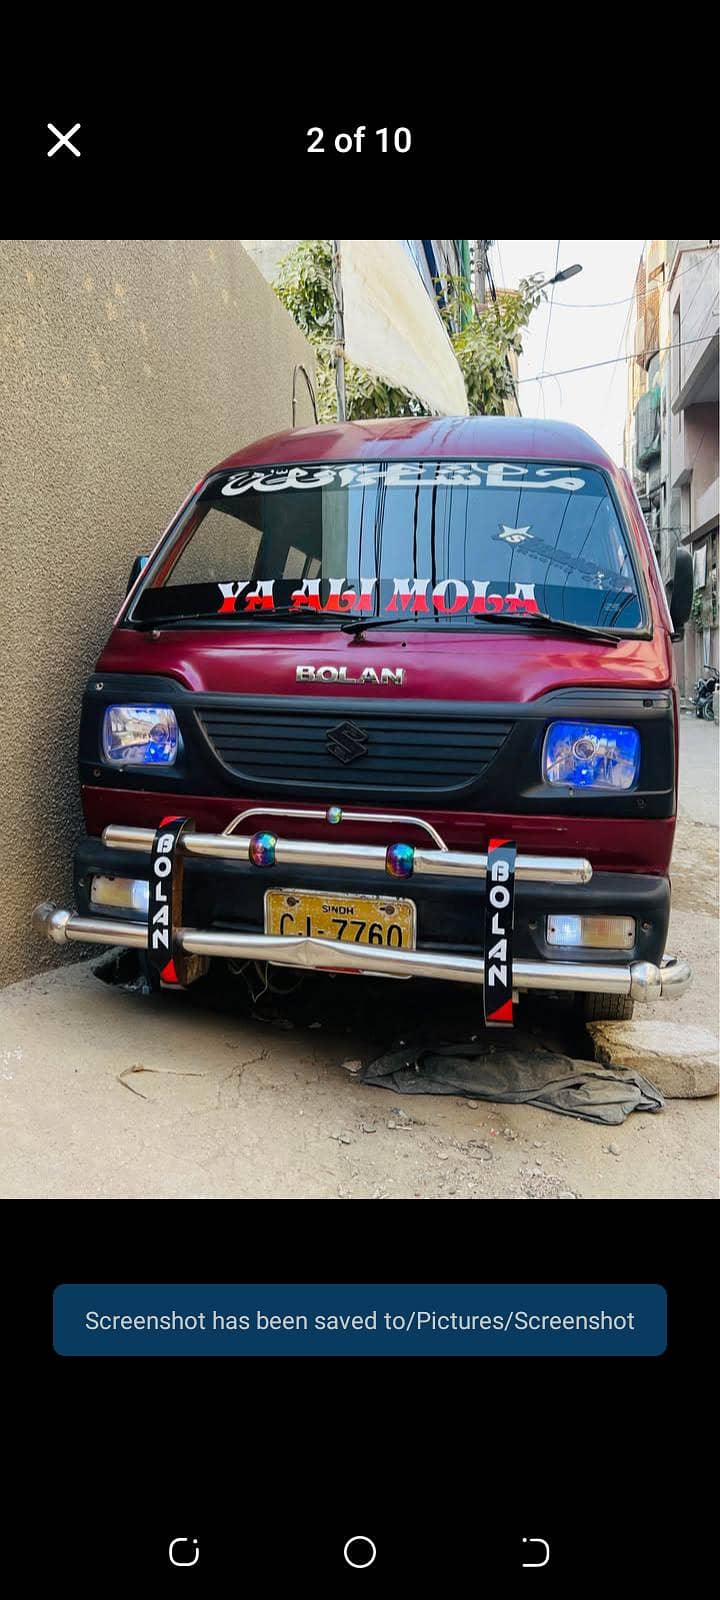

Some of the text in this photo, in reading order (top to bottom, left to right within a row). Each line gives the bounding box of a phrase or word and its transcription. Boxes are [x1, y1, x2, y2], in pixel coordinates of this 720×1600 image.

[218, 577, 540, 615] YA ALI MOLA
[296, 665, 405, 685] BOLAN
[152, 833, 175, 950] BOLAN
[322, 904, 354, 915] SINDH
[488, 860, 511, 987] BOLAN
